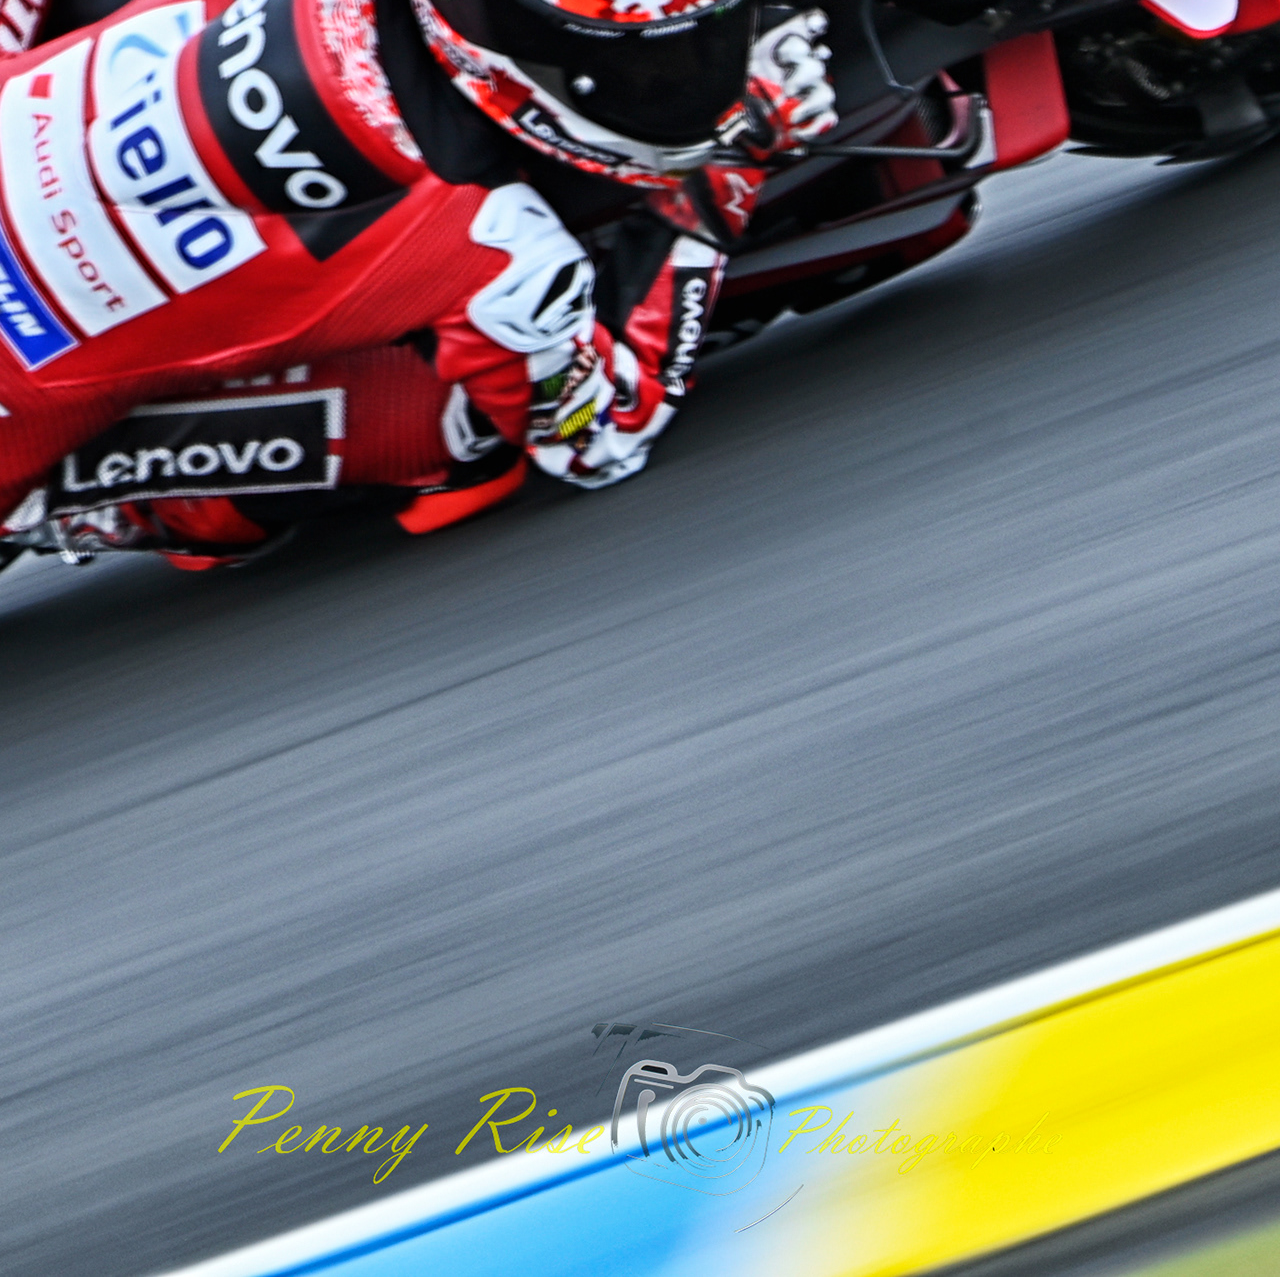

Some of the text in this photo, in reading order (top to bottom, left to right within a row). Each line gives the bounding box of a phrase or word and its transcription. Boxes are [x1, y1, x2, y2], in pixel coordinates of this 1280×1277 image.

[30, 113, 127, 313] Audi Sport
[108, 69, 235, 271] iello
[62, 436, 305, 494] Lenovo
